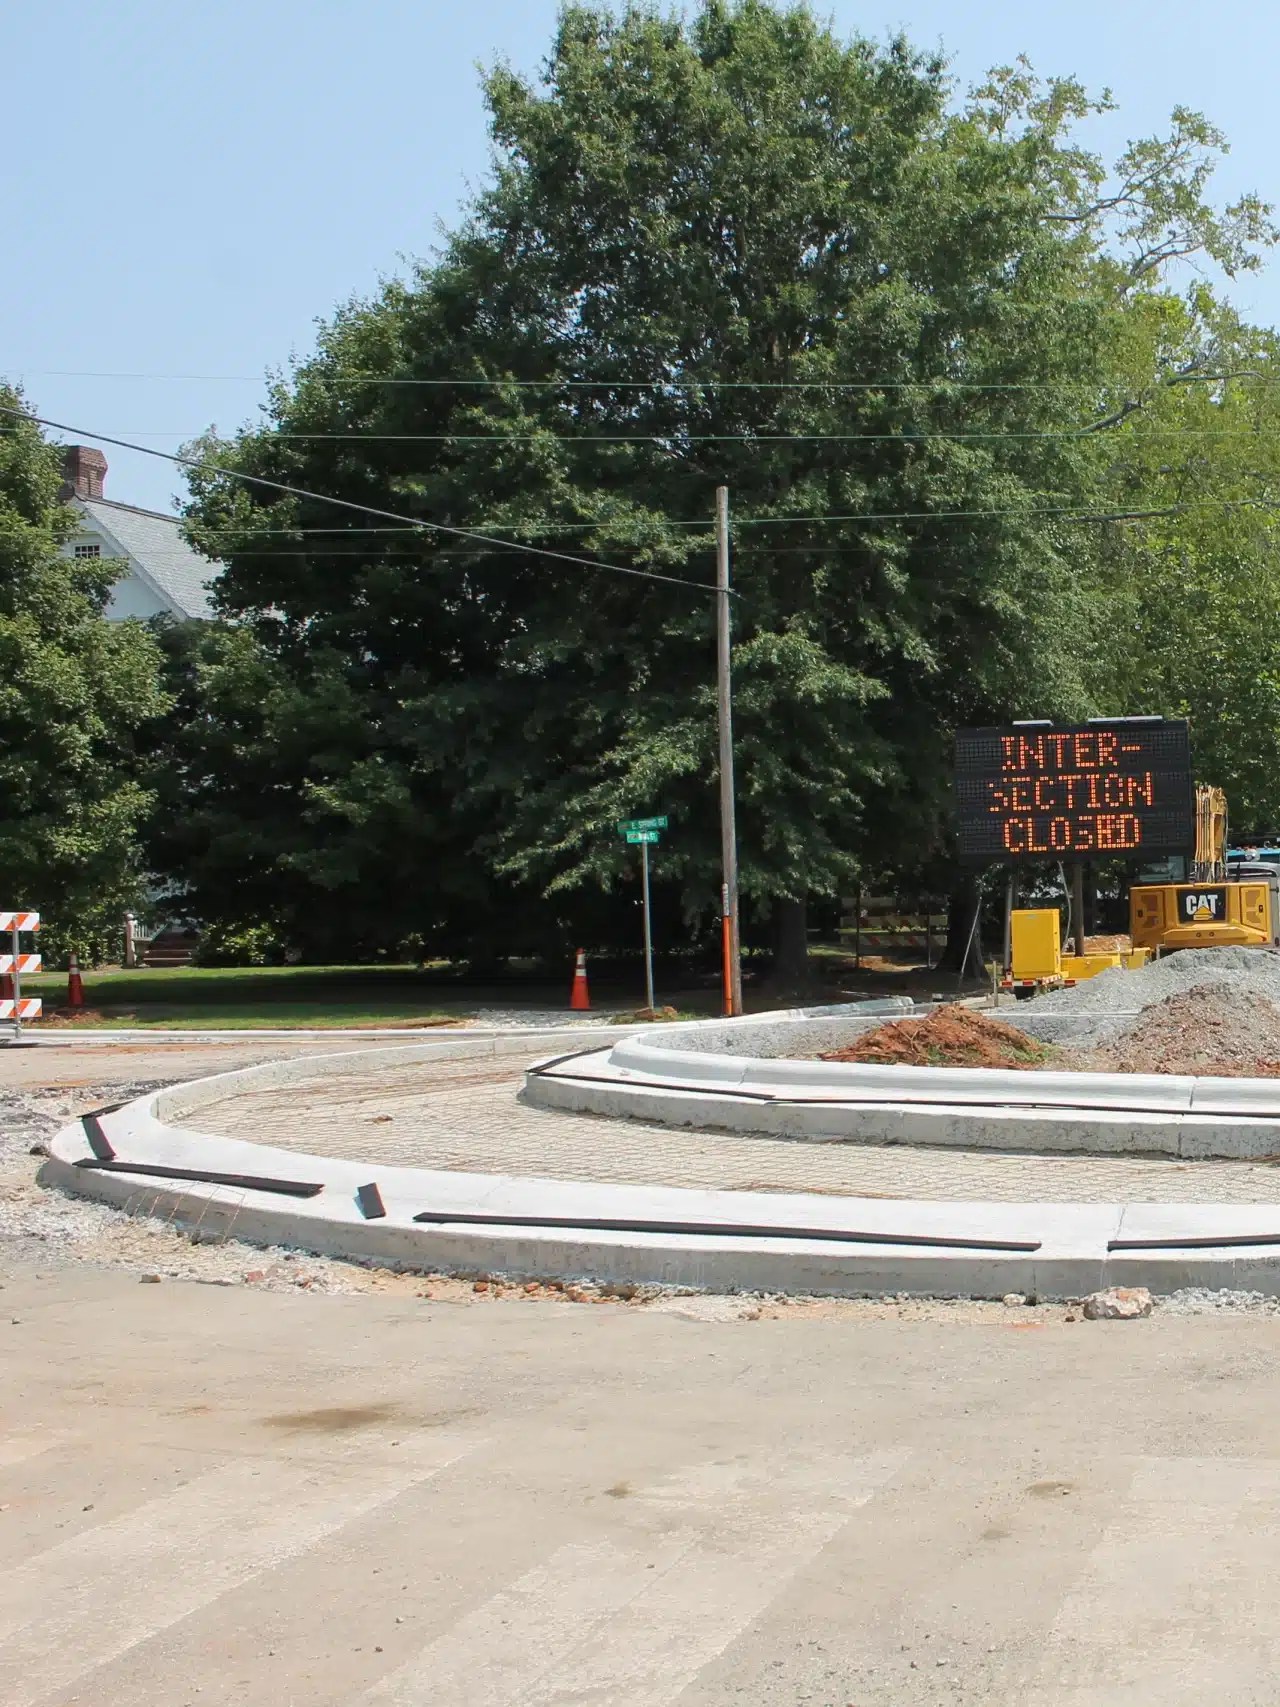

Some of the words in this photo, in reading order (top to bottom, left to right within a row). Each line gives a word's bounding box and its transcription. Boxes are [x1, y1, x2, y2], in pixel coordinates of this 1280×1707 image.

[1001, 732, 1141, 770] INTER-
[987, 771, 1152, 812] SECTION
[1003, 813, 1141, 852] CLOSED
[1185, 894, 1219, 916] CAT
